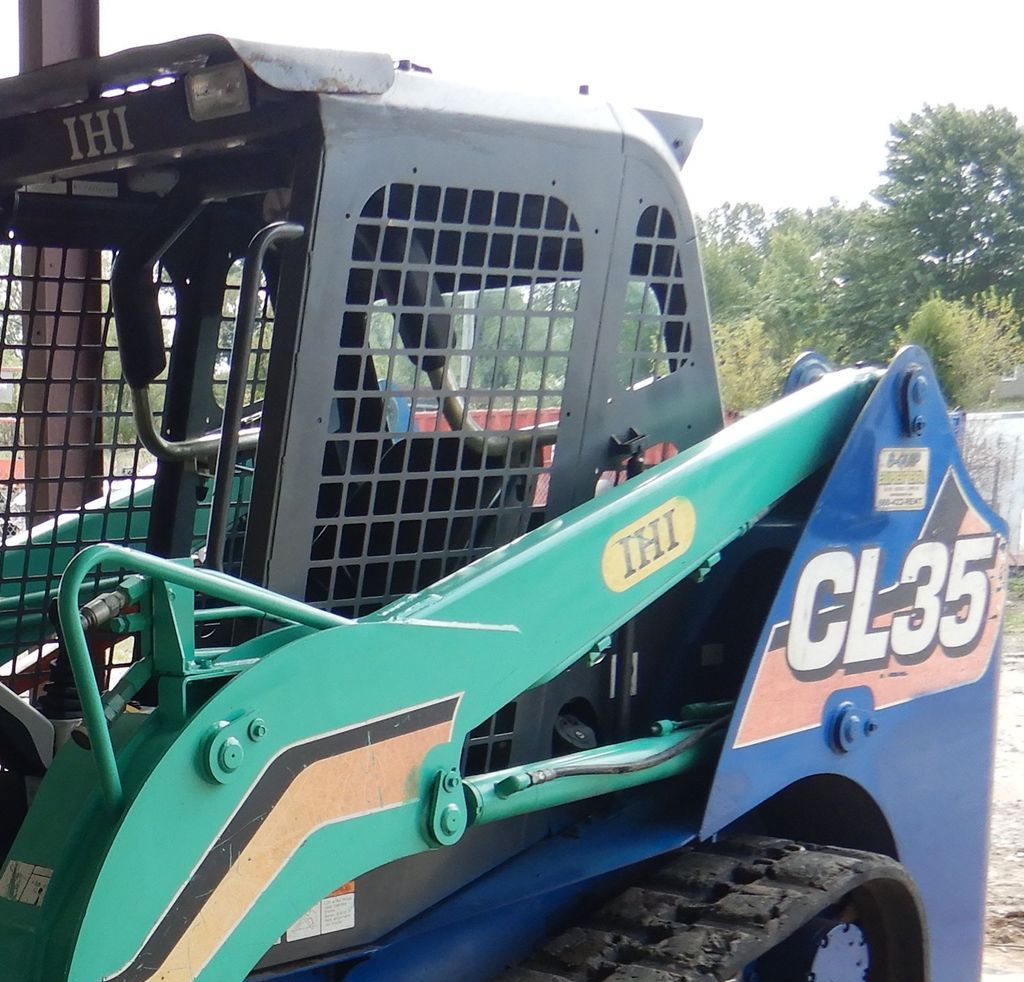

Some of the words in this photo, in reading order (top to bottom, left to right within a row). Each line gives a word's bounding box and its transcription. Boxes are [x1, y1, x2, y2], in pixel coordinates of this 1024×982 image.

[62, 105, 134, 160] IHI
[613, 508, 679, 579] IHI
[786, 536, 994, 675] CL35
